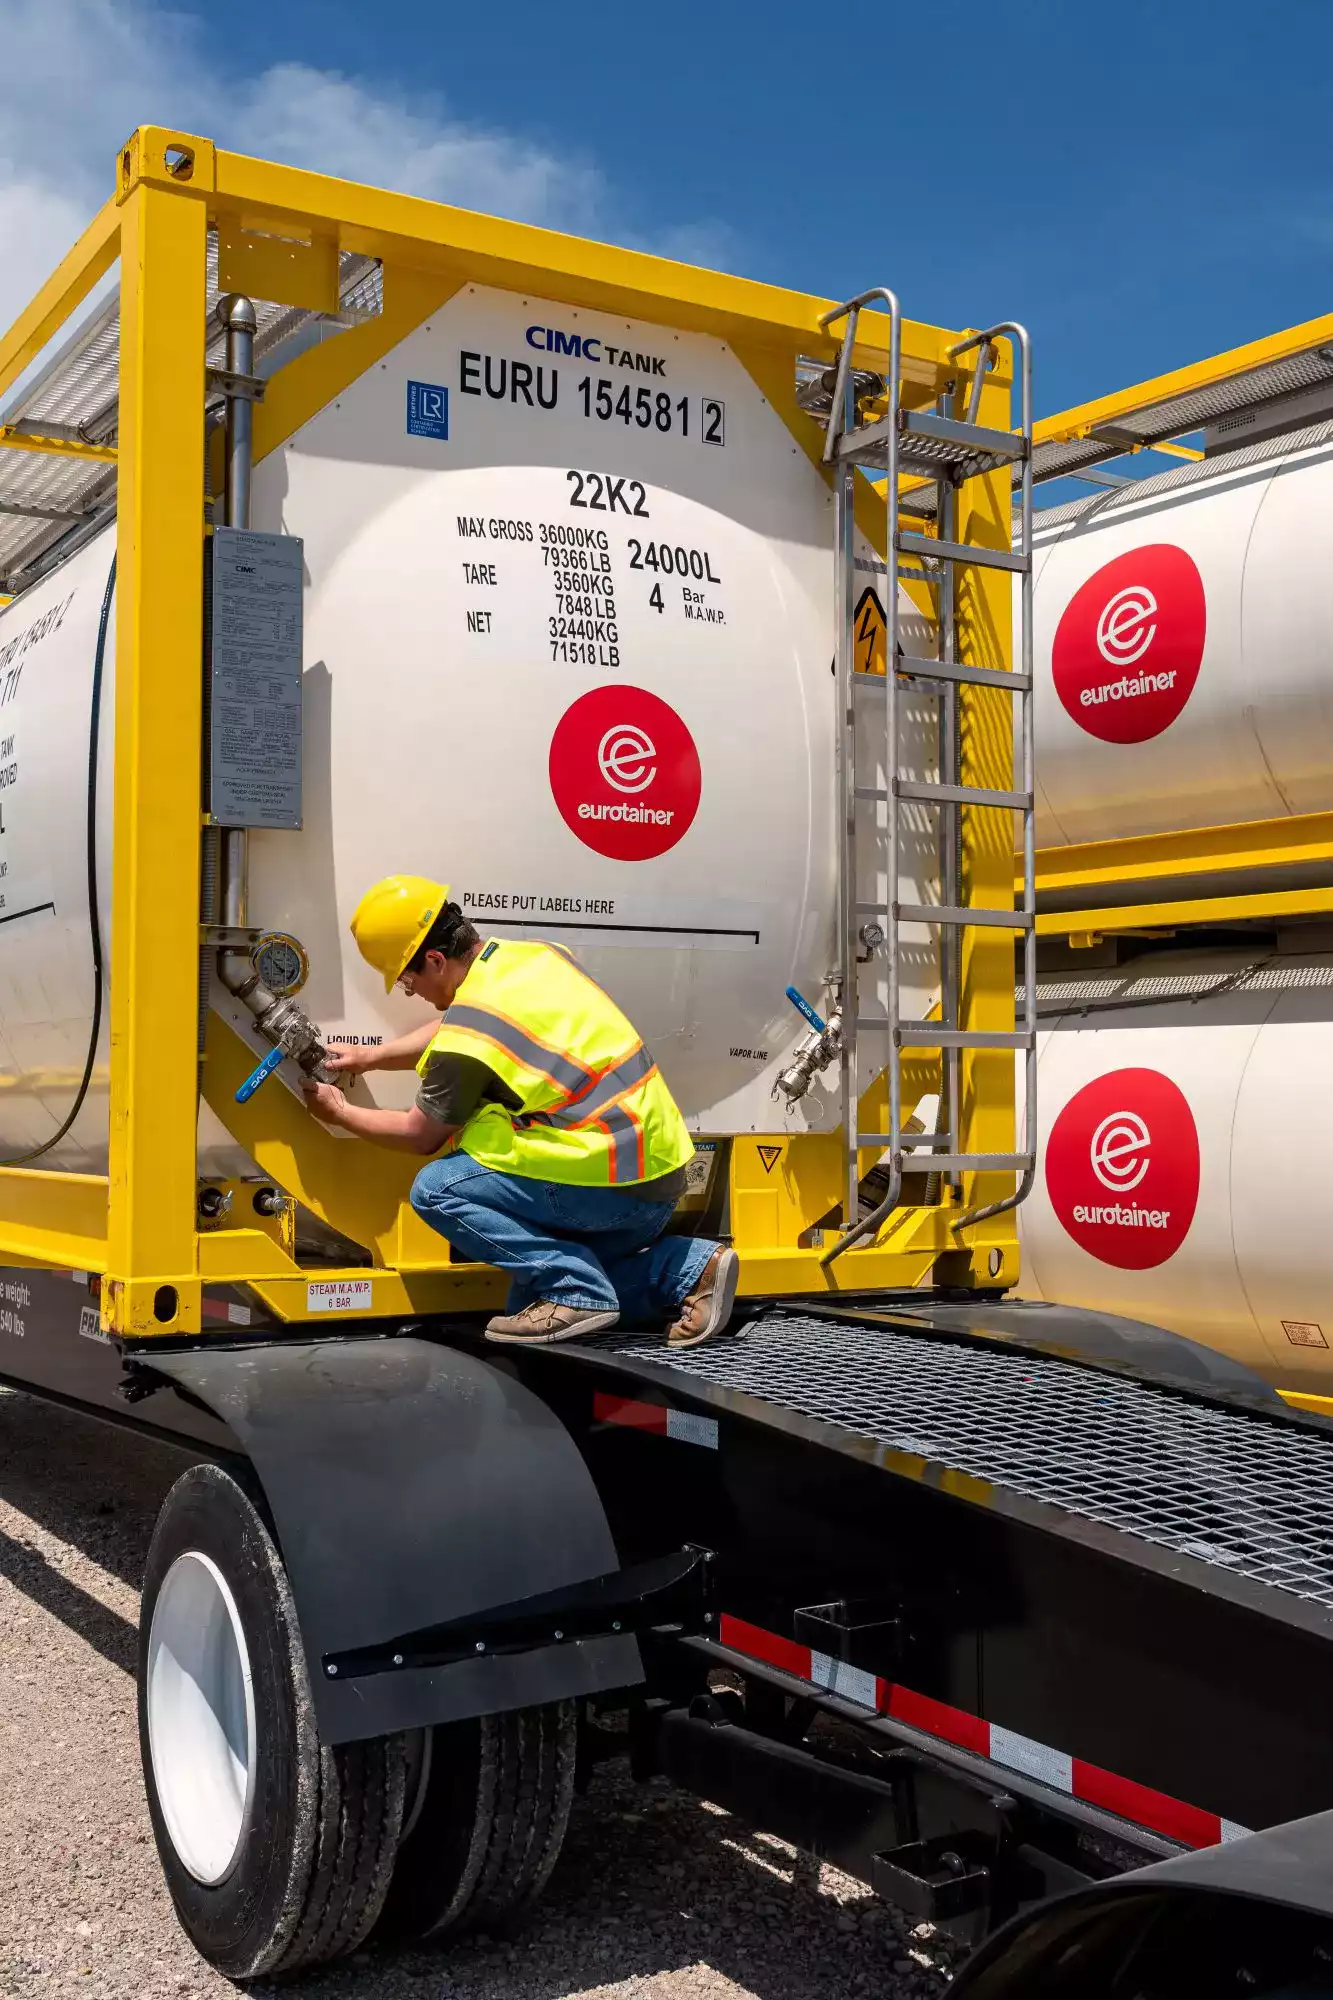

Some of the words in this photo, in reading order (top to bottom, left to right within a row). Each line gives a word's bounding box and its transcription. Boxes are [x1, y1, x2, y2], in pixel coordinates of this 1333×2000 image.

[526, 326, 600, 362] CIMC
[605, 346, 666, 376] TANK
[460, 350, 558, 410] EURU
[578, 376, 688, 436] 154581
[705, 402, 722, 444] 2
[566, 470, 650, 518] 22K2
[457, 516, 486, 538] MAX
[489, 519, 534, 542] GROSS
[538, 523, 609, 550] 36000KG
[235, 565, 257, 575] CIMC
[541, 546, 587, 571] 79366
[590, 551, 611, 573] LB
[627, 538, 721, 584] 24000L
[463, 563, 497, 585] TARE
[553, 570, 614, 596] 3560KG
[555, 594, 593, 617] 7848
[595, 598, 616, 620] LB
[649, 583, 665, 614] 4
[683, 587, 705, 604] Bar
[466, 611, 492, 633] NET
[549, 617, 619, 643] 32440KG
[684, 604, 727, 625] M.A.W.P.
[550, 641, 596, 665] 71518
[599, 645, 620, 667] LB
[1080, 669, 1177, 706] eurotainer
[577, 802, 674, 825] eurotainer
[463, 892, 509, 909] PLEASE
[511, 895, 537, 910] PUT
[539, 897, 582, 913] LABELS
[585, 900, 615, 914] HERE
[361, 1036, 383, 1046] LINE
[729, 1047, 752, 1059] VAPOR
[752, 1050, 768, 1061] LINE
[1073, 1201, 1170, 1229] eurotainer
[5, 1281, 31, 1309] weight:
[309, 1284, 337, 1295] STEAM
[338, 1282, 370, 1294] M.A.W.P.
[328, 1298, 333, 1308] 6
[336, 1297, 351, 1308] BAR
[14, 1312, 25, 1337] lbs
[81, 1310, 103, 1338] PRA
